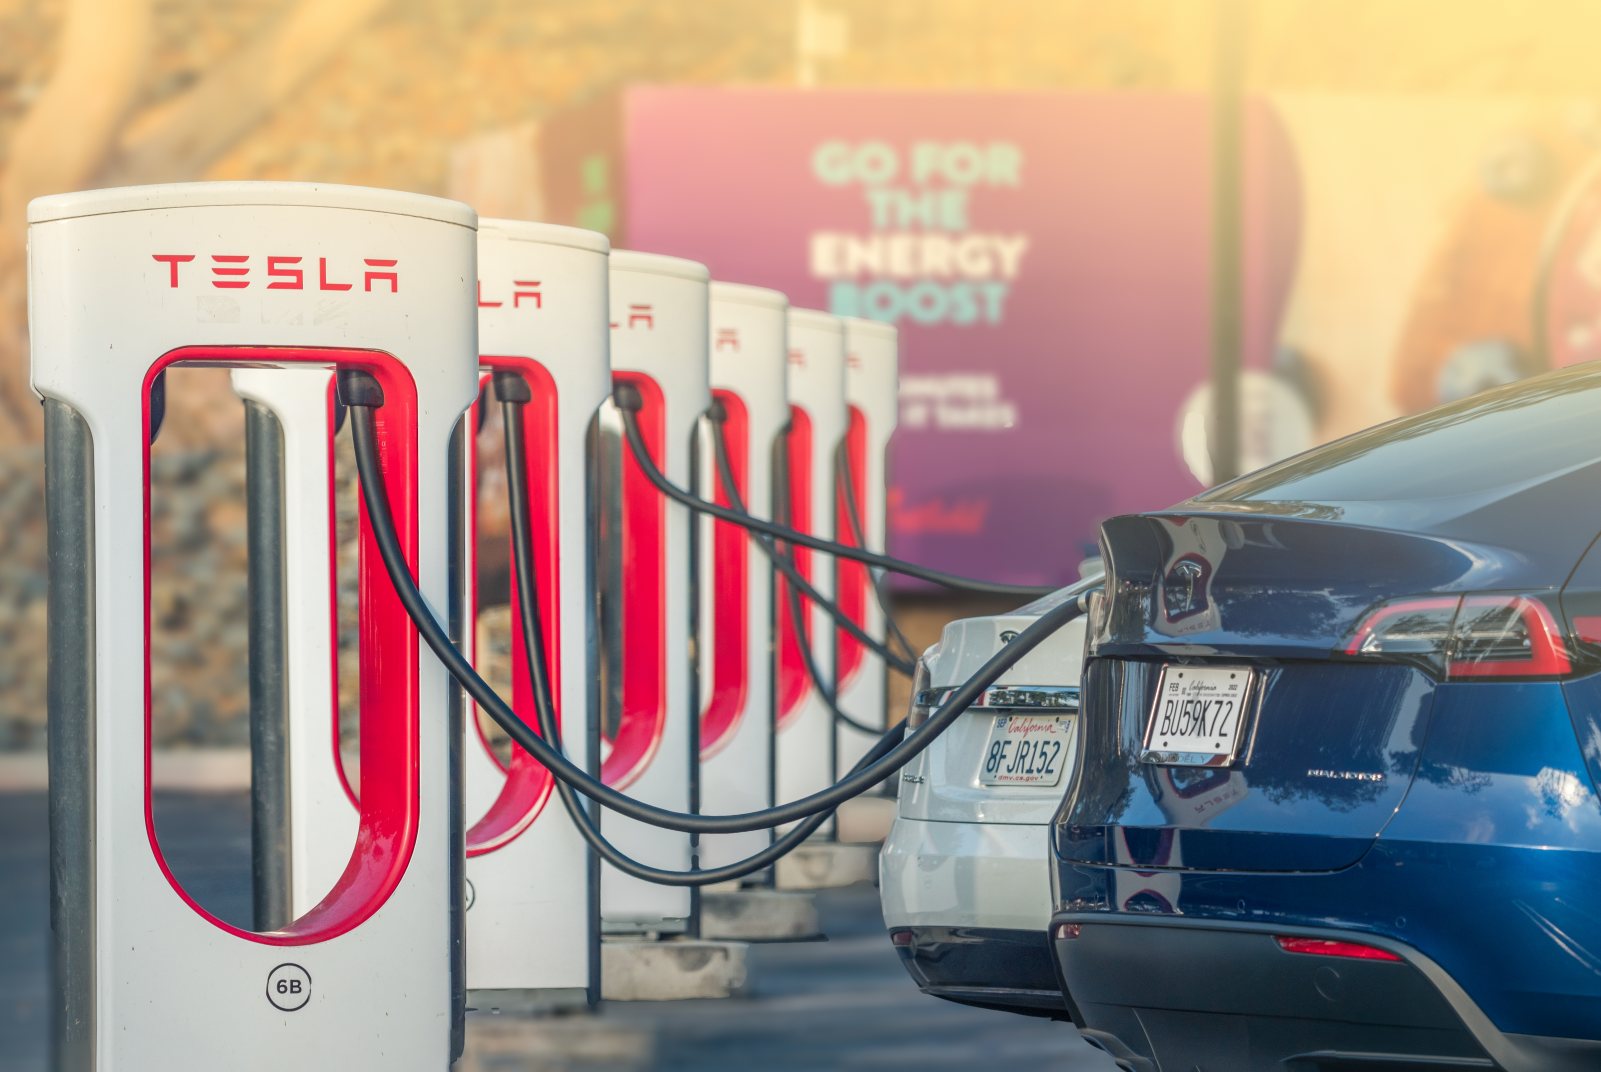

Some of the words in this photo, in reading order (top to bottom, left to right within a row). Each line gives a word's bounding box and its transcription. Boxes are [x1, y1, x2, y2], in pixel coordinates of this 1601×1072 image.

[811, 141, 898, 186] GO
[911, 141, 1022, 188] FOR
[867, 189, 967, 231] THE
[152, 255, 398, 293] TESLA
[810, 232, 1028, 279] ENERGY
[1008, 716, 1056, 738] California
[1160, 699, 1234, 737] BU59K72
[986, 740, 1061, 774] 8FJR152
[276, 979, 302, 994] 6B
